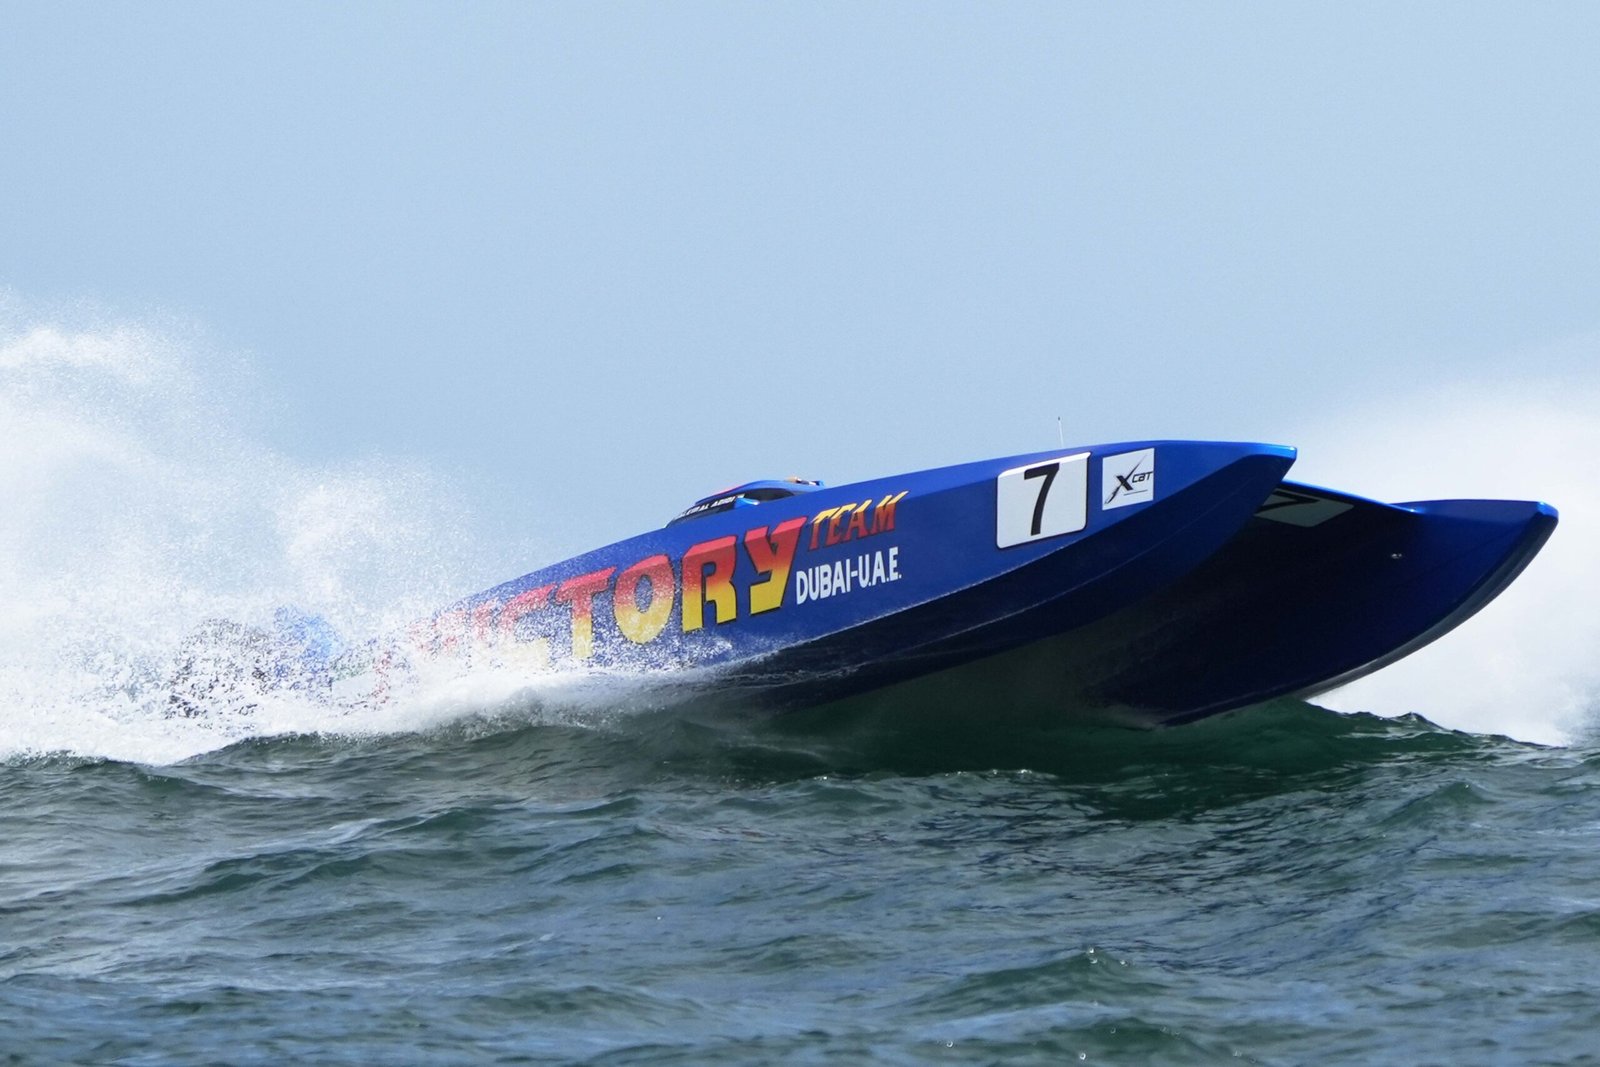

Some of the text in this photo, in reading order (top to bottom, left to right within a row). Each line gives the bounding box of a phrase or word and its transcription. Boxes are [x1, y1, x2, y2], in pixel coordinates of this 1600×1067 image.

[809, 490, 909, 552] TEAM
[1023, 462, 1060, 537] 7
[796, 546, 902, 605] DUBAI-U.A.E.
